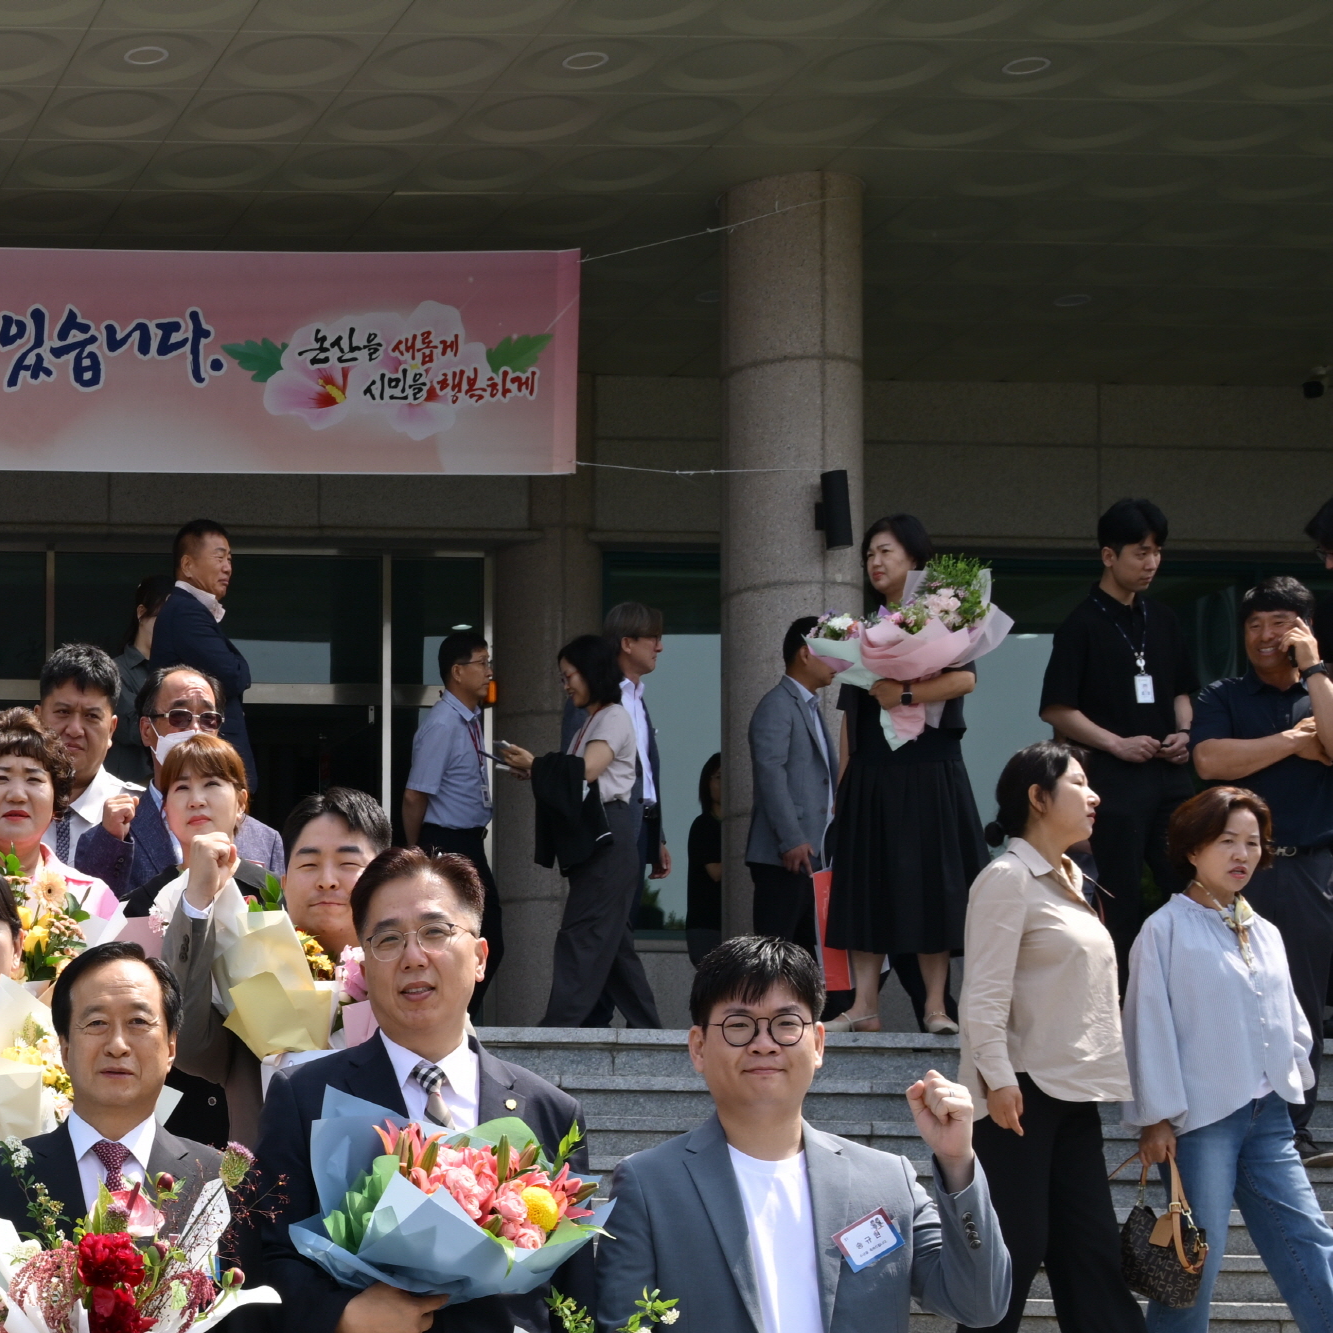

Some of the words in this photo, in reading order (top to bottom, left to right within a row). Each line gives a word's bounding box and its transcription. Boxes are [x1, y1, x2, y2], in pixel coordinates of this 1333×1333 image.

[298, 327, 383, 366] 논산을
[391, 330, 460, 364] 새롭게
[363, 368, 428, 402] 시민을
[436, 368, 538, 404] 행복하게
